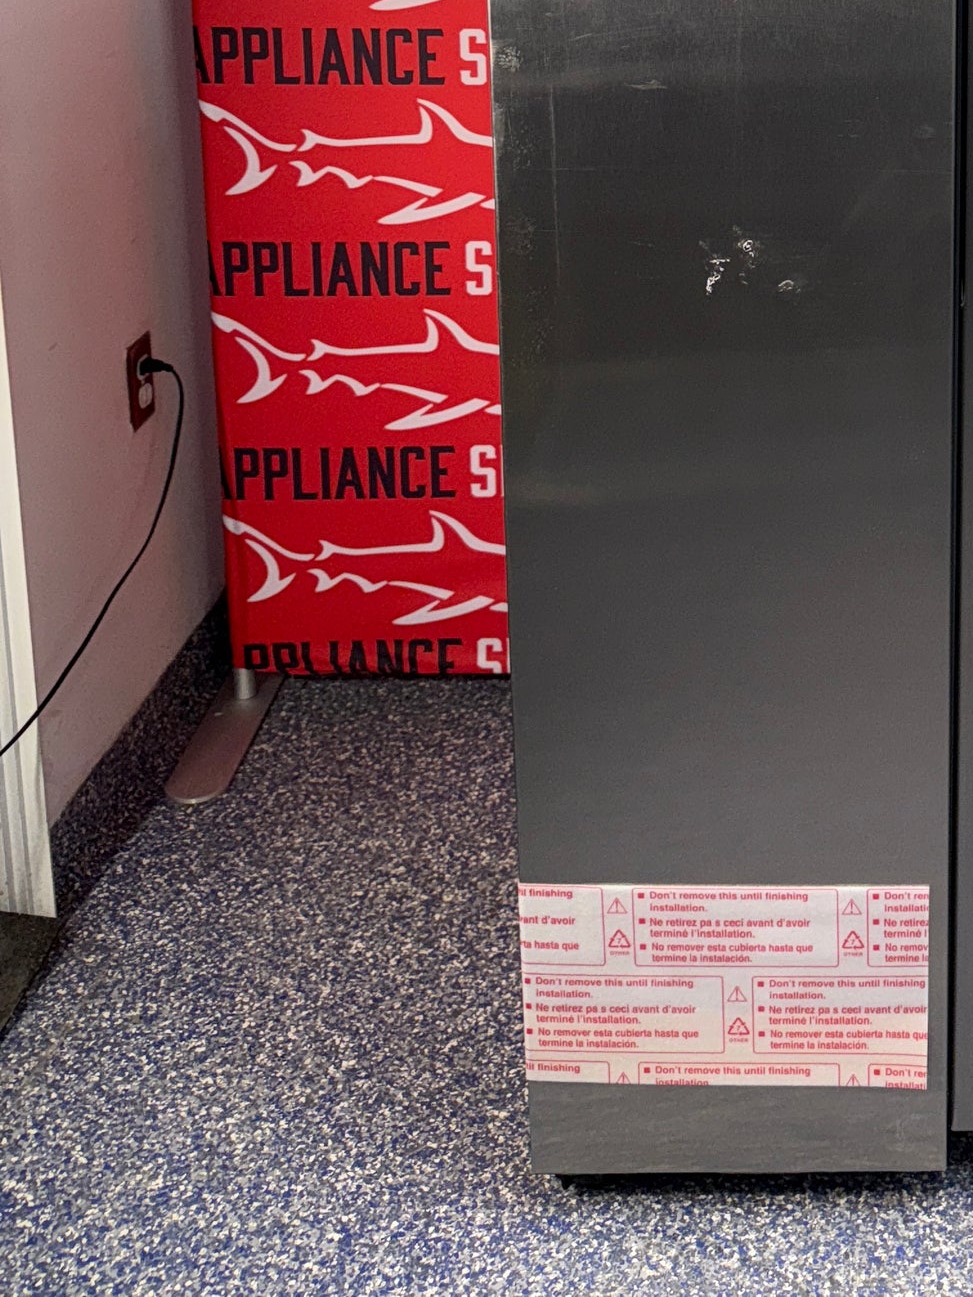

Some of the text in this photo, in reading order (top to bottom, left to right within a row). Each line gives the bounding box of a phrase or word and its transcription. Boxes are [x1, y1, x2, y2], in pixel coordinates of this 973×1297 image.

[538, 1028, 699, 1040] No remover esta cubierta hasta que
[538, 1039, 573, 1048] termine
[575, 1039, 584, 1048] la
